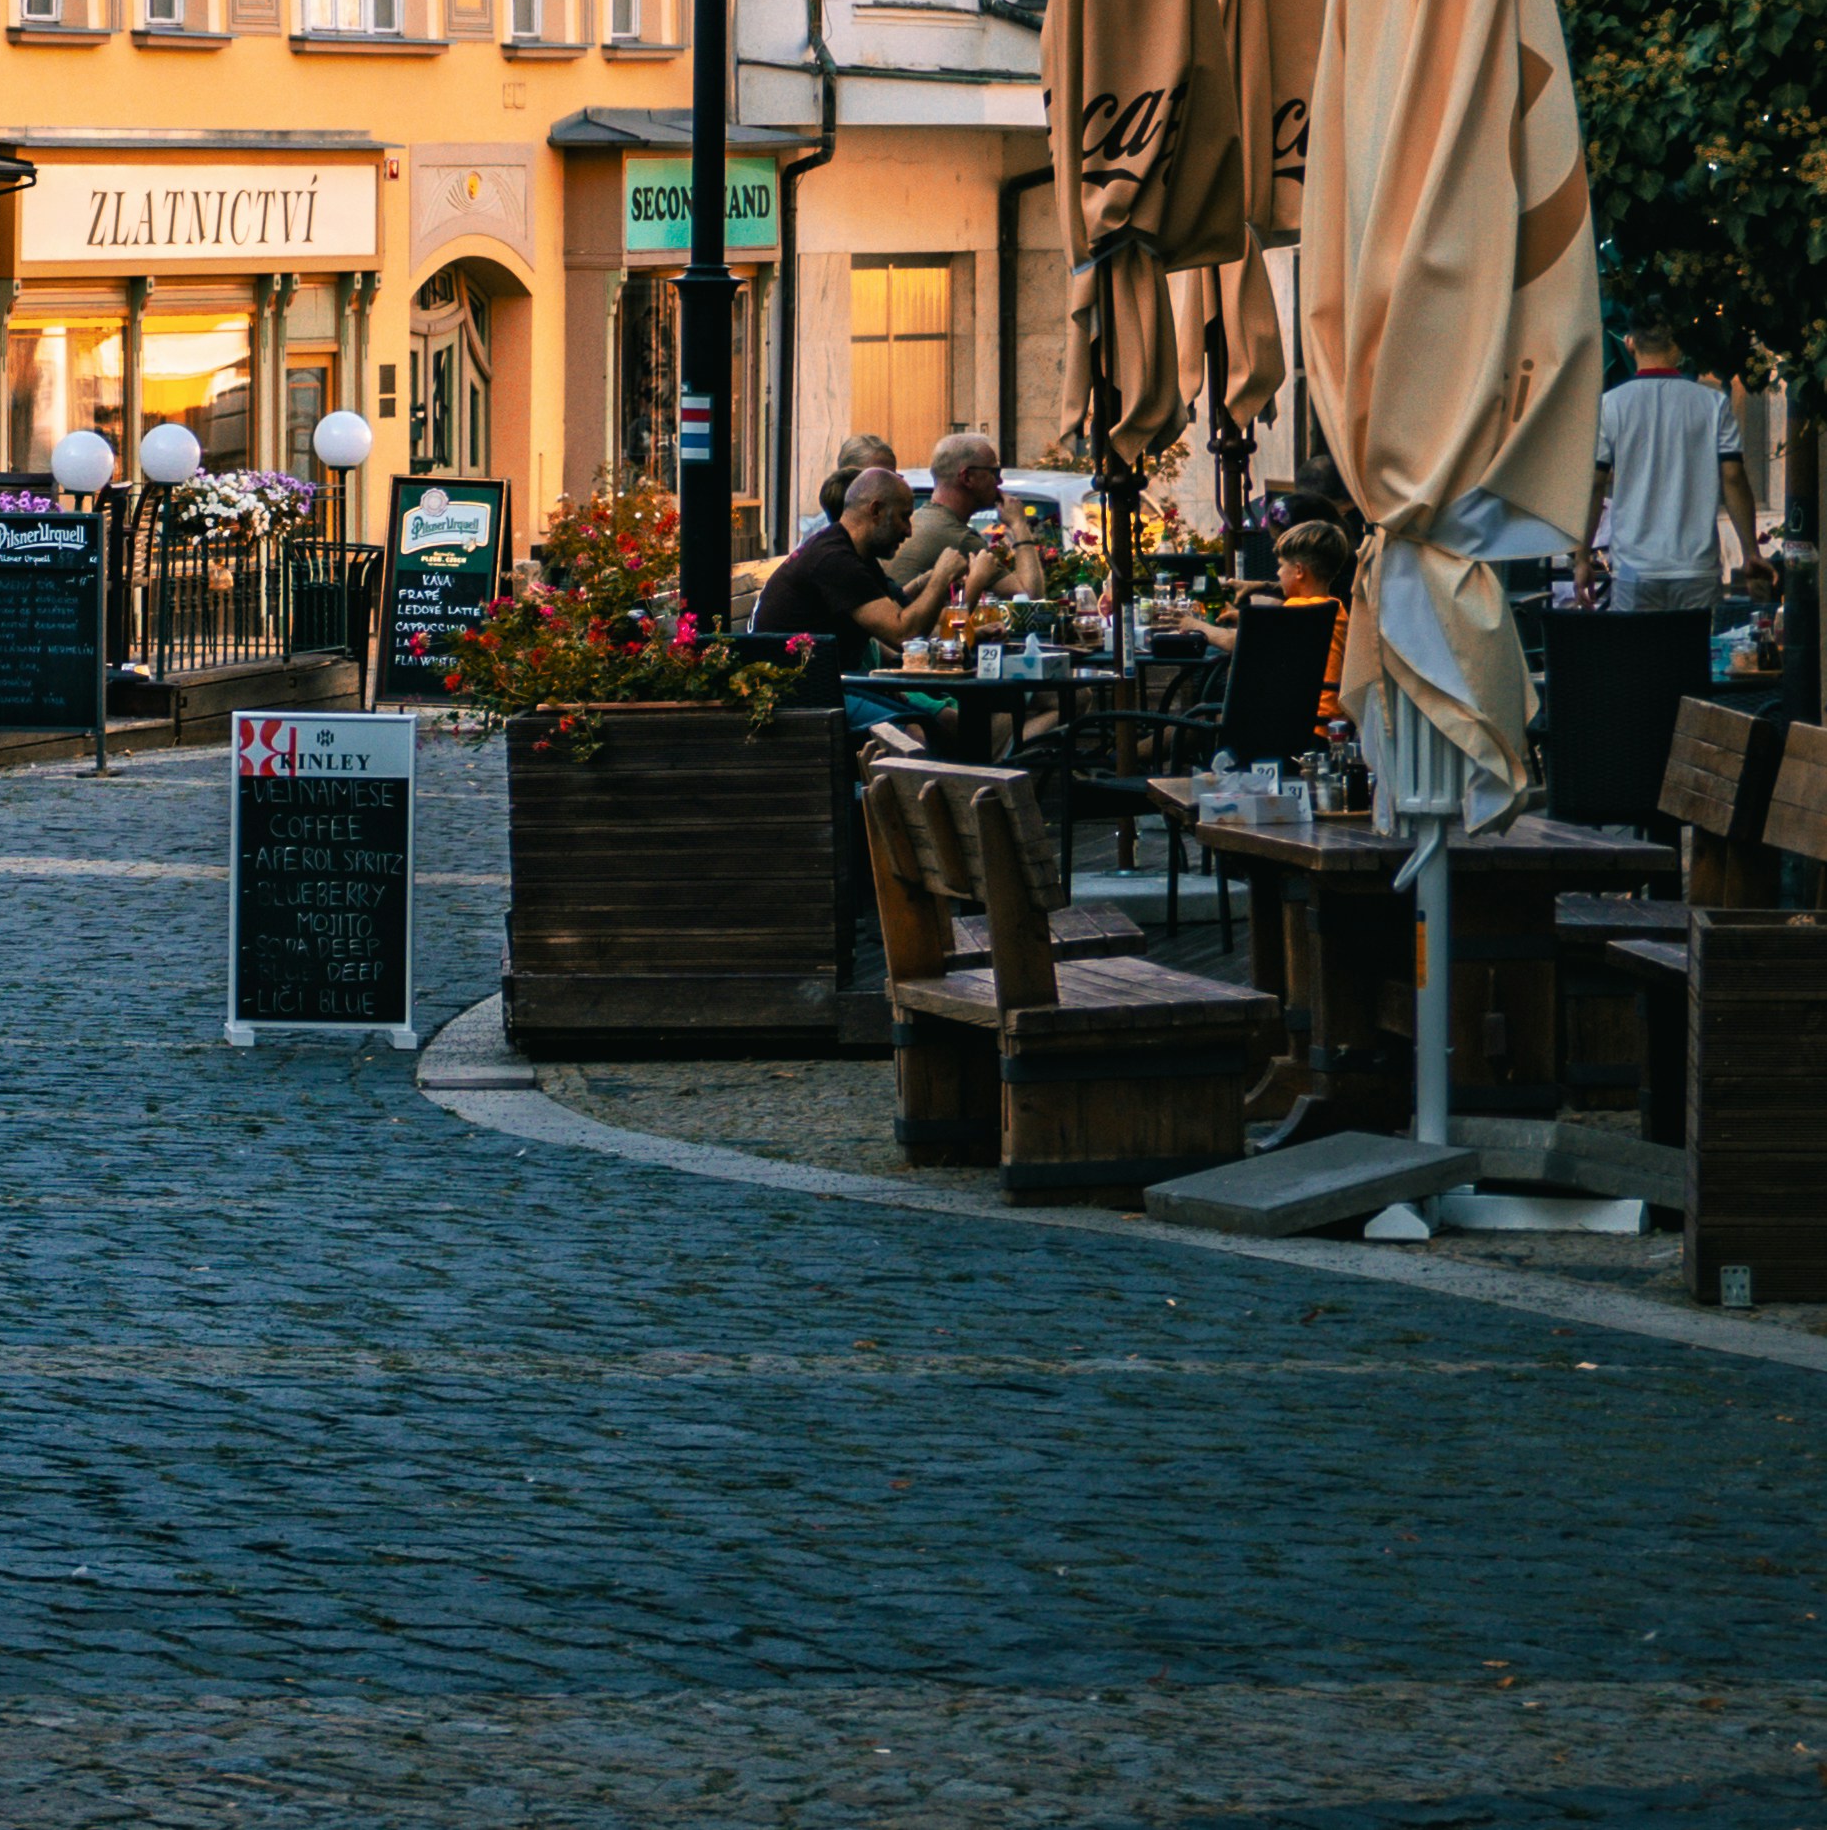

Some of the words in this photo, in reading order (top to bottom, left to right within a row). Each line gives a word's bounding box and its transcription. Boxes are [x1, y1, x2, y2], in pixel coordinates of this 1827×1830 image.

[86, 173, 319, 248] ZLATNICTVÍ
[631, 186, 693, 221] SECON
[724, 184, 771, 220] AND
[37, 522, 85, 550] Urquell
[411, 515, 445, 541] Pilsner
[446, 516, 479, 536] Urquell
[398, 588, 440, 601] FRAPÉ
[397, 602, 442, 615] LEDOVÉ
[447, 605, 481, 617] LATTE
[981, 648, 998, 661] 29
[279, 752, 372, 771] KINLEY
[253, 778, 395, 809] VIETNAMESE
[269, 813, 363, 841] COFFEE
[255, 846, 338, 872] APEROL
[343, 849, 404, 875] SPRITZ
[257, 880, 386, 908] BLUEBERRY
[297, 911, 373, 938] MOJITO
[255, 934, 312, 959] SODA
[317, 936, 381, 960] DEEP
[327, 961, 385, 982] DEEP
[319, 988, 376, 1016] BLUE
